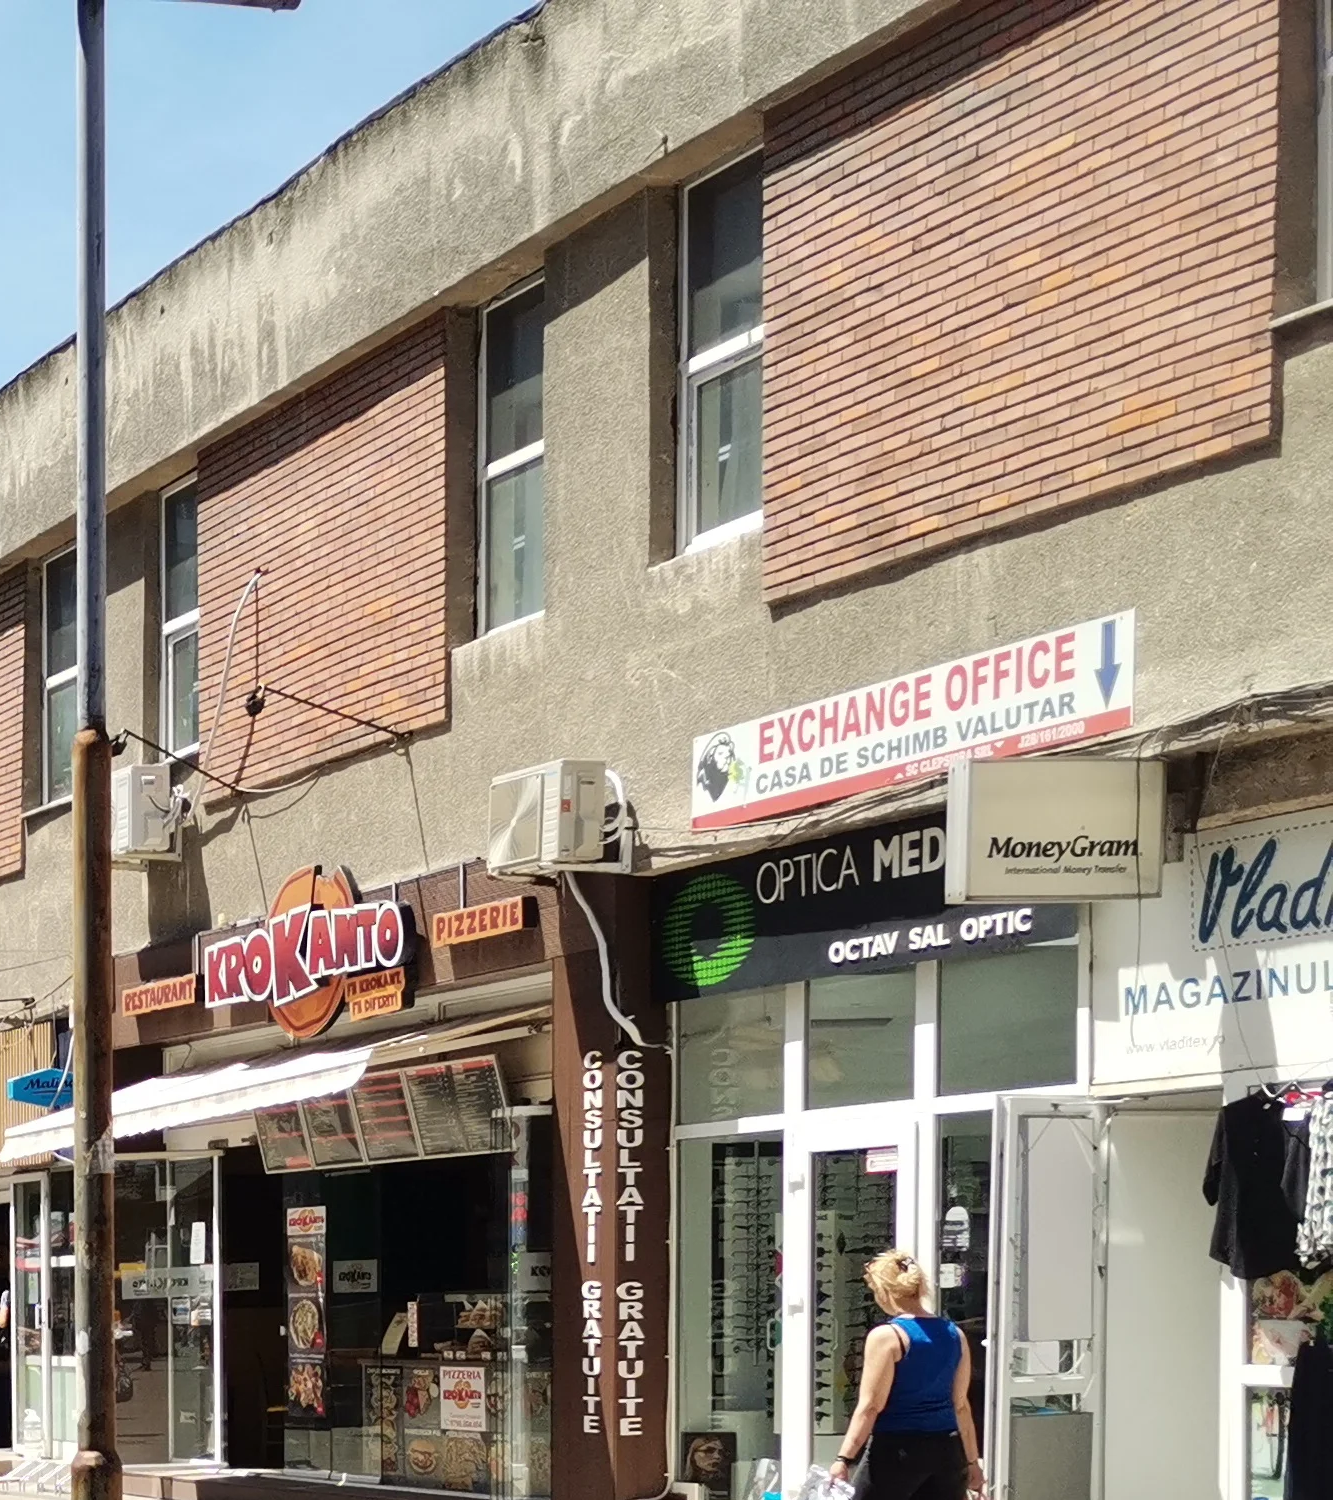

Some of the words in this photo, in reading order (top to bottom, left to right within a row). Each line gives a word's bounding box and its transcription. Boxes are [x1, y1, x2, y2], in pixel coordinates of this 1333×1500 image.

[759, 673, 932, 765] EXCHANGE
[945, 631, 1076, 712] OFFICE
[755, 762, 812, 795] CASA
[820, 752, 849, 779] DE
[856, 725, 947, 769] SCHIMB
[956, 692, 1077, 741] VALUTAR
[756, 845, 860, 904] OPTICA
[873, 827, 946, 882] MED
[987, 835, 1138, 863] MoneyGram
[1004, 865, 1061, 875] International
[1063, 865, 1092, 876] Money
[1094, 864, 1128, 873] Transfer
[1197, 836, 1333, 944] Vlad
[205, 902, 404, 1009] KROKANTO
[436, 902, 520, 940] PIZZERIE
[828, 930, 900, 964] OCTAV
[908, 924, 950, 951] SAL
[960, 908, 1033, 942] OPTIC
[124, 977, 195, 1013] RESTAURANT
[1124, 959, 1333, 1017] MAGAZINUL
[582, 1050, 603, 1263] CONSULTATII
[616, 1050, 645, 1262] CONSULTATII
[443, 1369, 482, 1380] PIZZERIA
[581, 1280, 602, 1434] GRATUITE
[616, 1281, 645, 1436] GRATUITE
